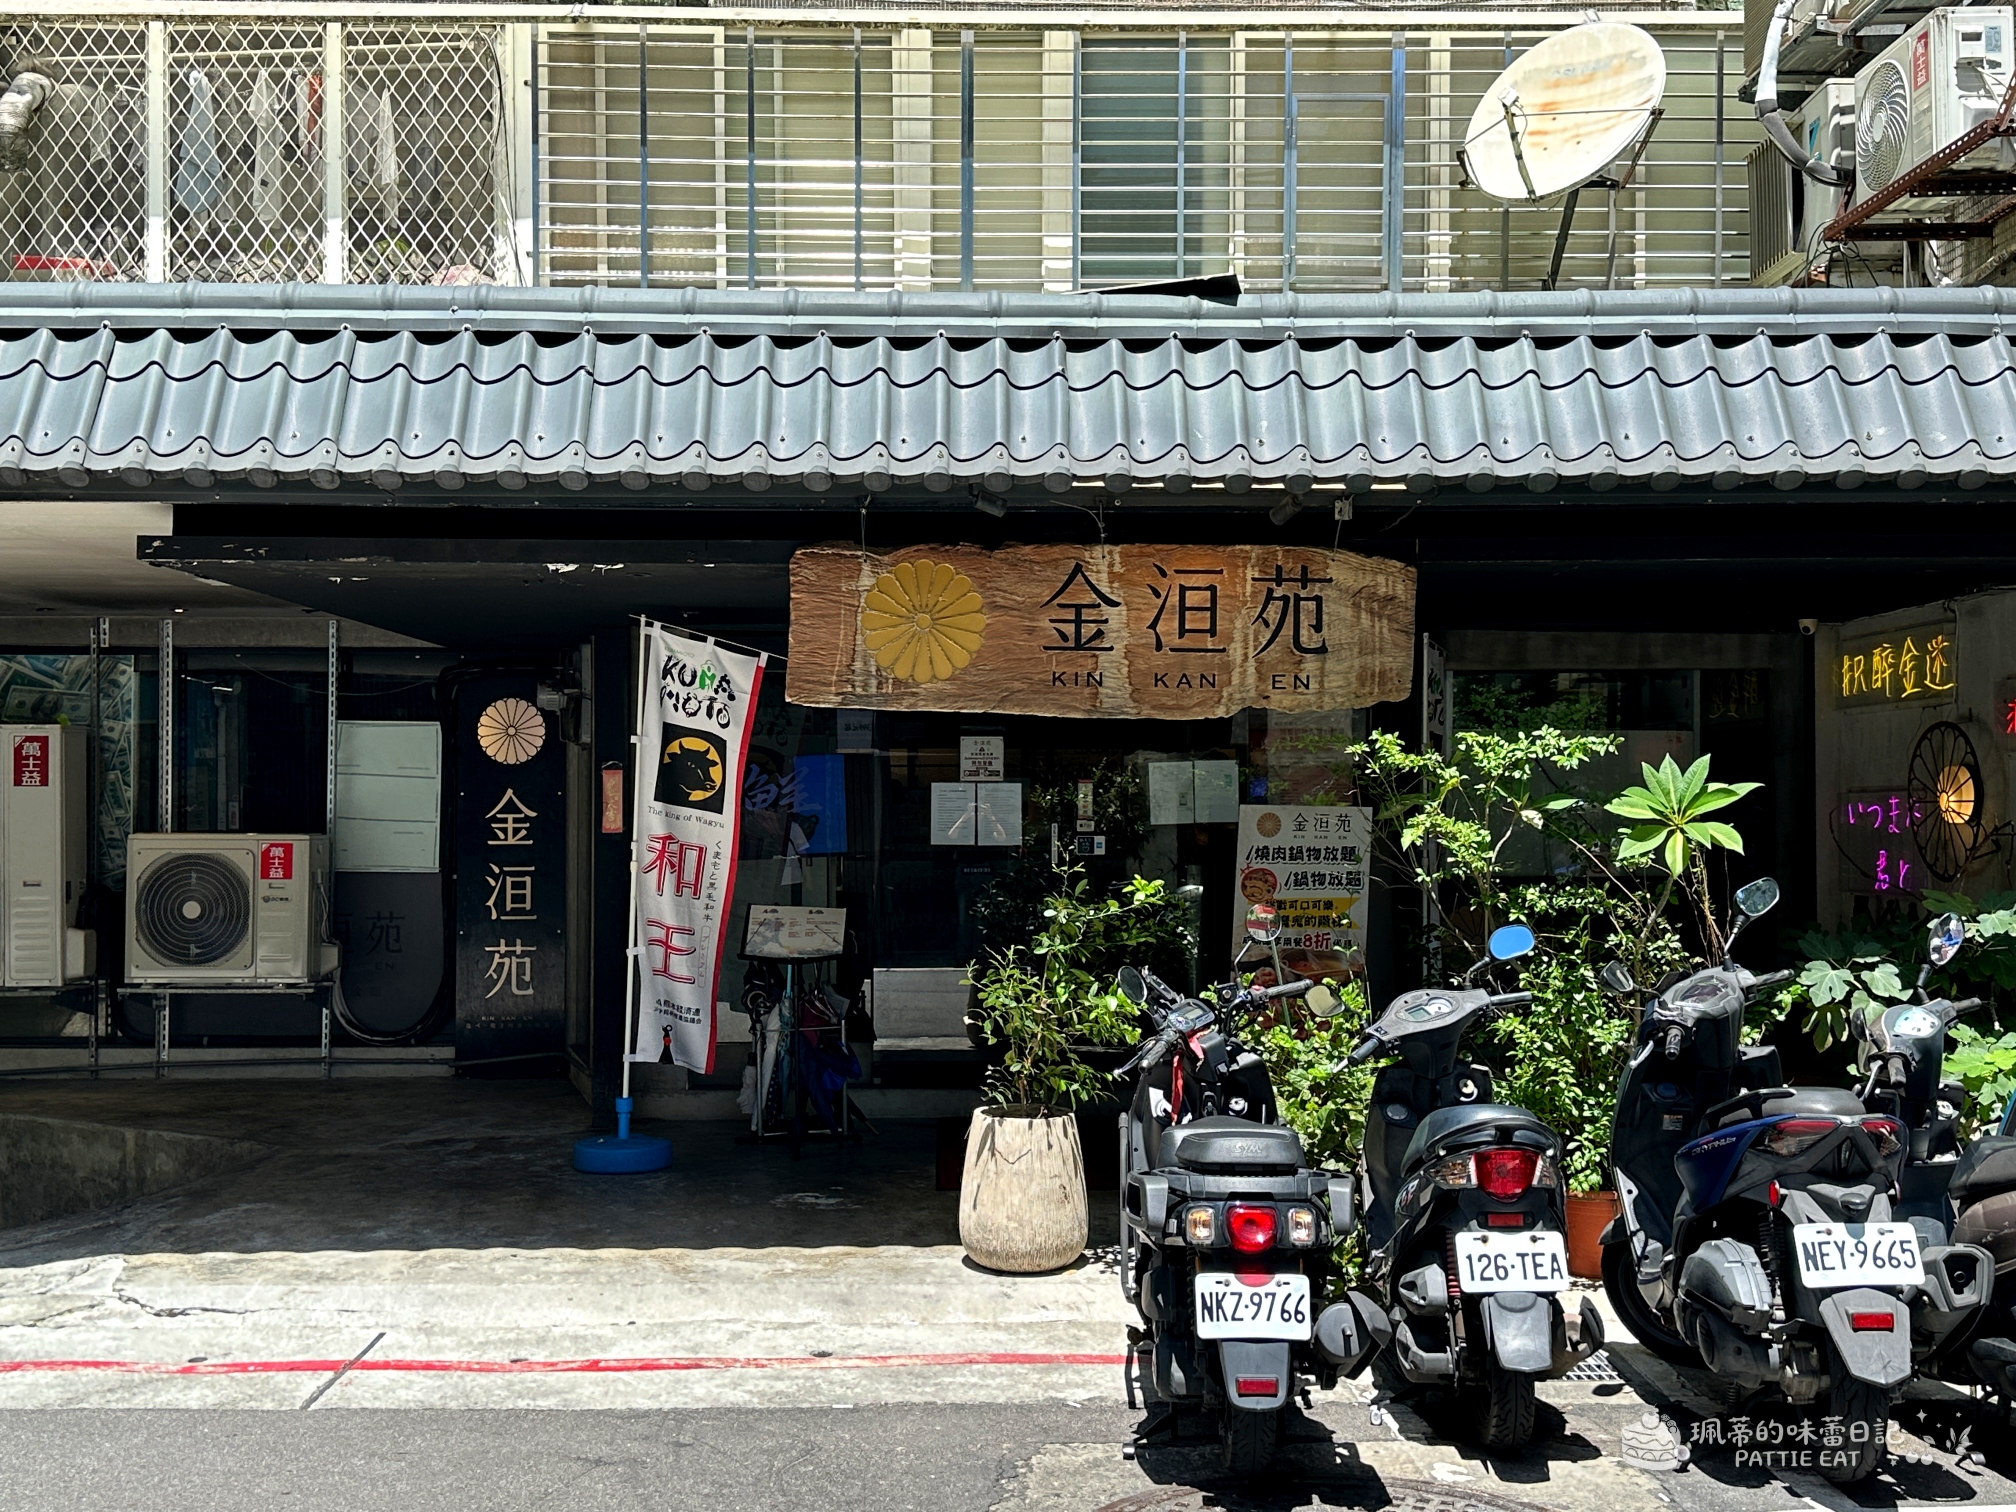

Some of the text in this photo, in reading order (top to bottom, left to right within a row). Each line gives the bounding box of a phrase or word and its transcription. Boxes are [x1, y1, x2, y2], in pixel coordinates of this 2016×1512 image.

[1040, 562, 1333, 659] 金洹苑
[1052, 671, 1310, 690] KIN KAN EN
[21, 742, 41, 785] 萬士益
[648, 805, 724, 828] The king of Wagyu
[1292, 812, 1352, 833] 金洹苑
[269, 847, 285, 878] 萬士益
[484, 788, 538, 999] 金洹苑
[1235, 1142, 1262, 1155] SYM
